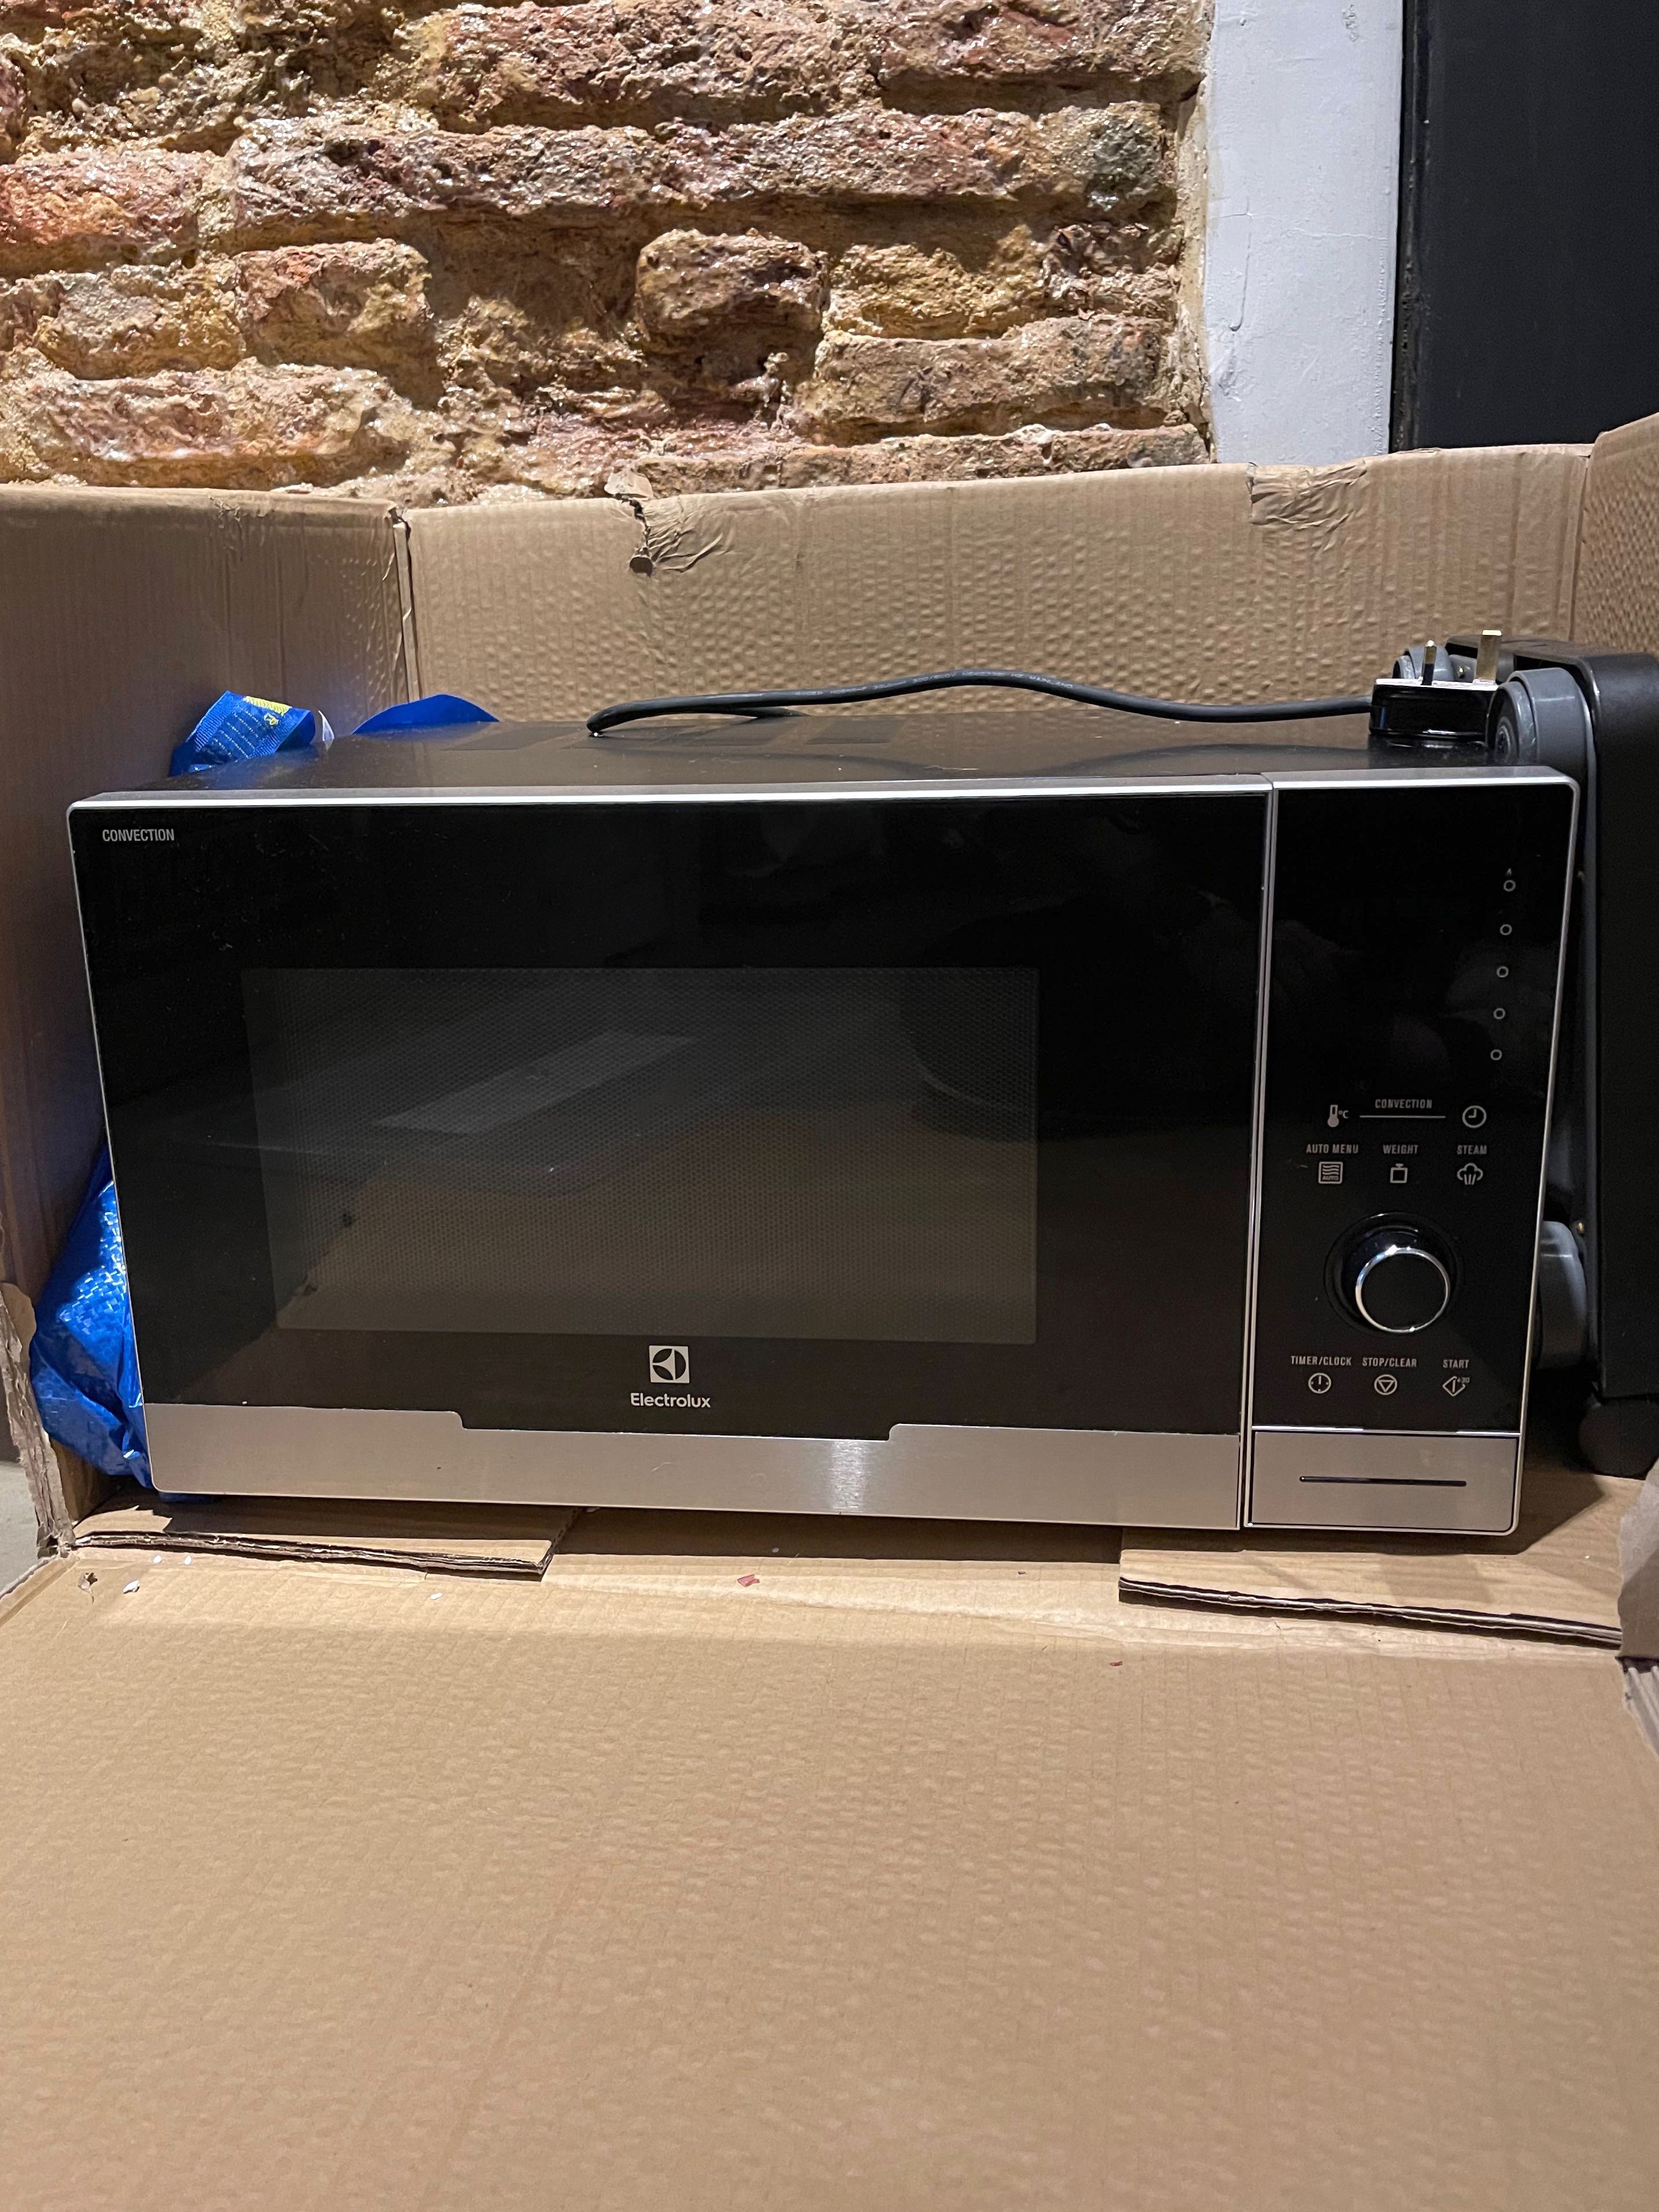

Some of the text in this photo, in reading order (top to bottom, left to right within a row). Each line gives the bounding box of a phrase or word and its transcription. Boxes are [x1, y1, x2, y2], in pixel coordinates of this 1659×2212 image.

[102, 829, 175, 842] CONVECTION
[1375, 1099, 1432, 1109] CONVECTION
[1306, 1144, 1359, 1154] AUTO MENU
[1383, 1144, 1419, 1155] WEIGHT
[1456, 1145, 1488, 1155] STEAM
[1291, 1355, 1352, 1366] TIMER/CLOCK
[1362, 1357, 1417, 1367] STOP/CLEAR
[1443, 1359, 1470, 1369] START
[630, 1392, 711, 1408] Electrolux
